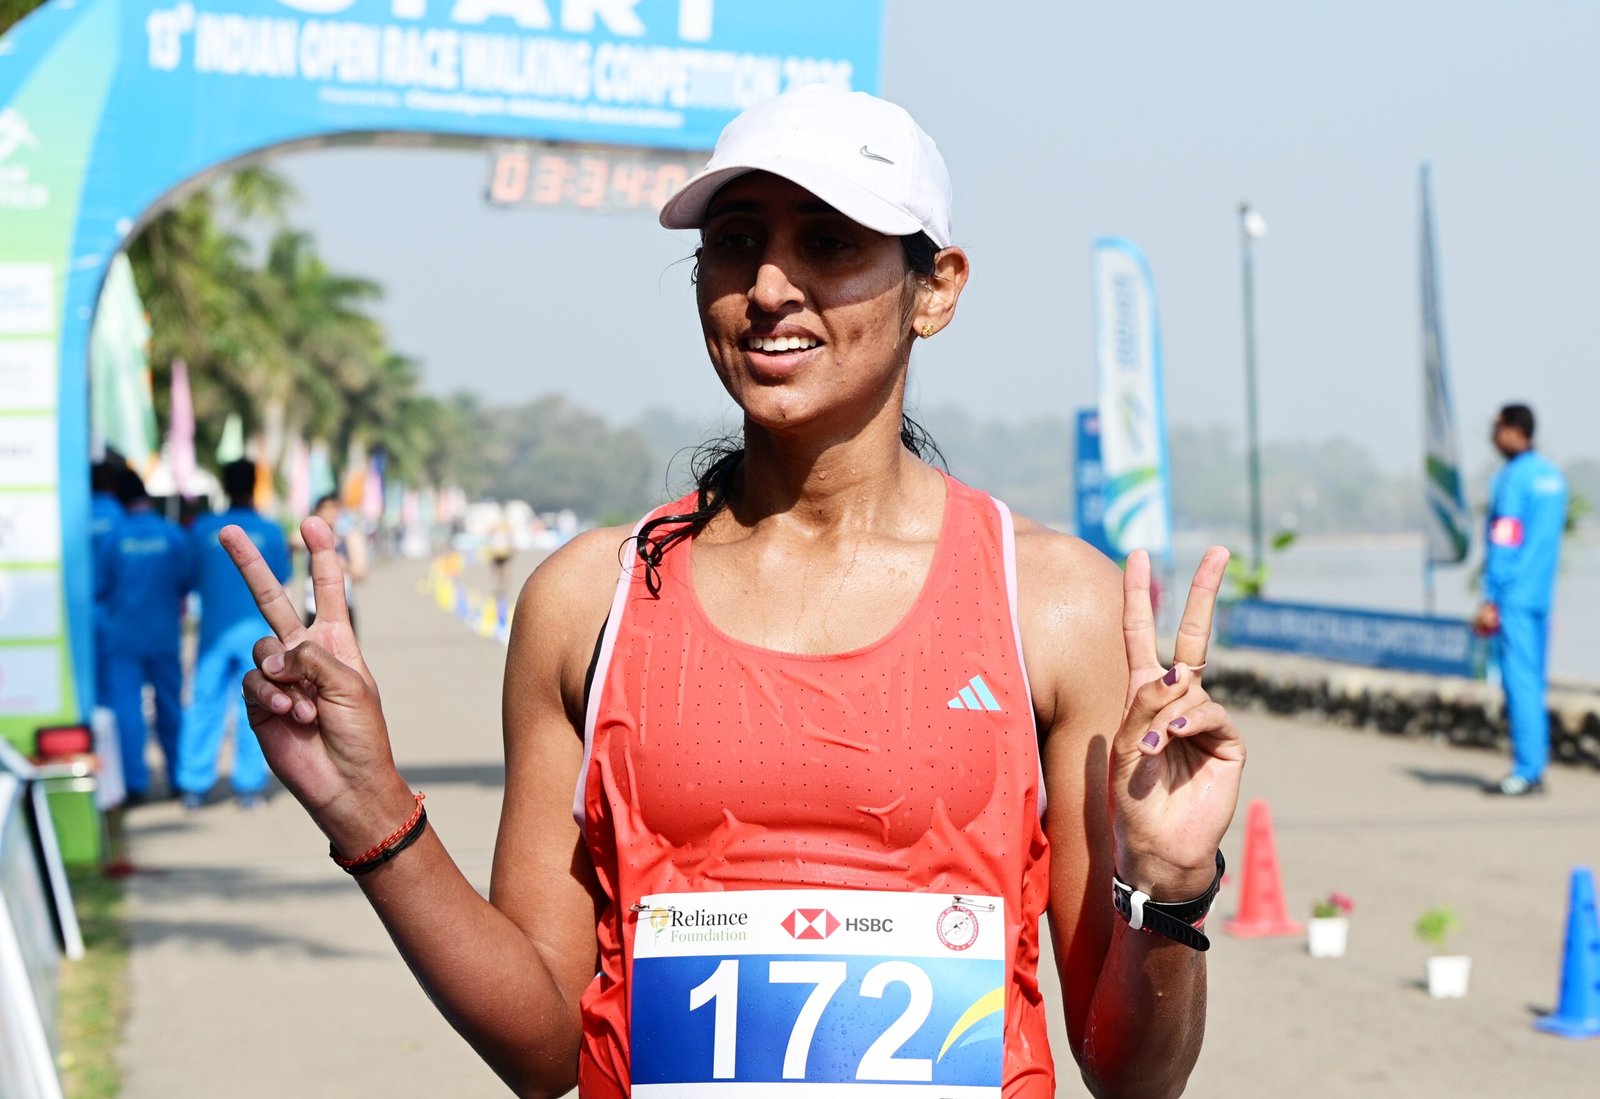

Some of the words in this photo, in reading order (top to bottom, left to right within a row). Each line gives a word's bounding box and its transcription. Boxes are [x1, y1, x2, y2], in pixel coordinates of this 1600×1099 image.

[196, 14, 296, 75] INDIAN
[301, 20, 380, 80] OPEN
[383, 26, 457, 87] RACE
[462, 32, 590, 100] WALKING
[491, 154, 704, 210] 03:34:0
[671, 910, 748, 927] Reliance
[845, 917, 894, 933] HSBC
[671, 929, 747, 943] Foundation
[689, 958, 934, 1082] 172
